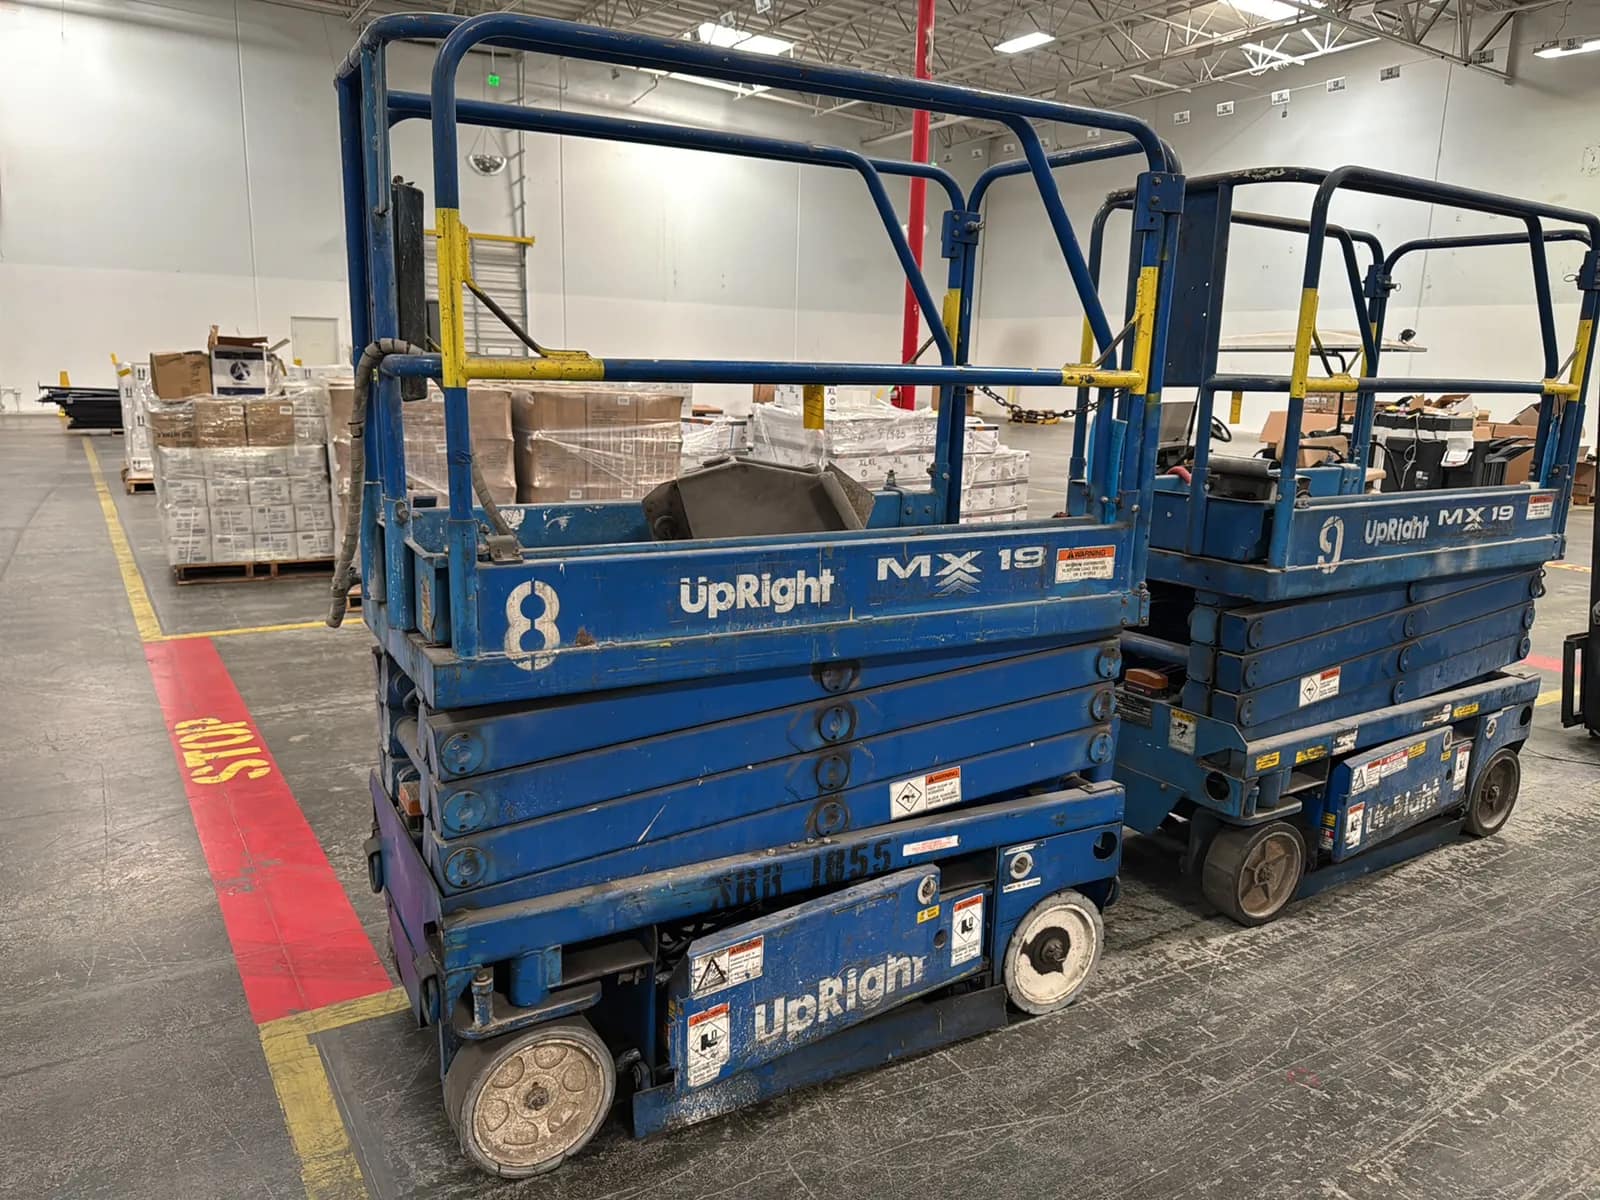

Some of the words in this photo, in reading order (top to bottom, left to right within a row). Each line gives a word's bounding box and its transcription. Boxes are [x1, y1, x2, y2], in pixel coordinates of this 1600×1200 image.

[1317, 516, 1344, 574] 9
[1438, 506, 1486, 526] MX
[1491, 505, 1515, 521] 19
[680, 568, 835, 619] UpRight
[877, 551, 982, 581] MX
[999, 546, 1046, 571] 19
[503, 580, 560, 671] 8
[175, 718, 271, 784] STOP
[812, 838, 891, 887] 1855
[755, 953, 927, 1043] UpRight
